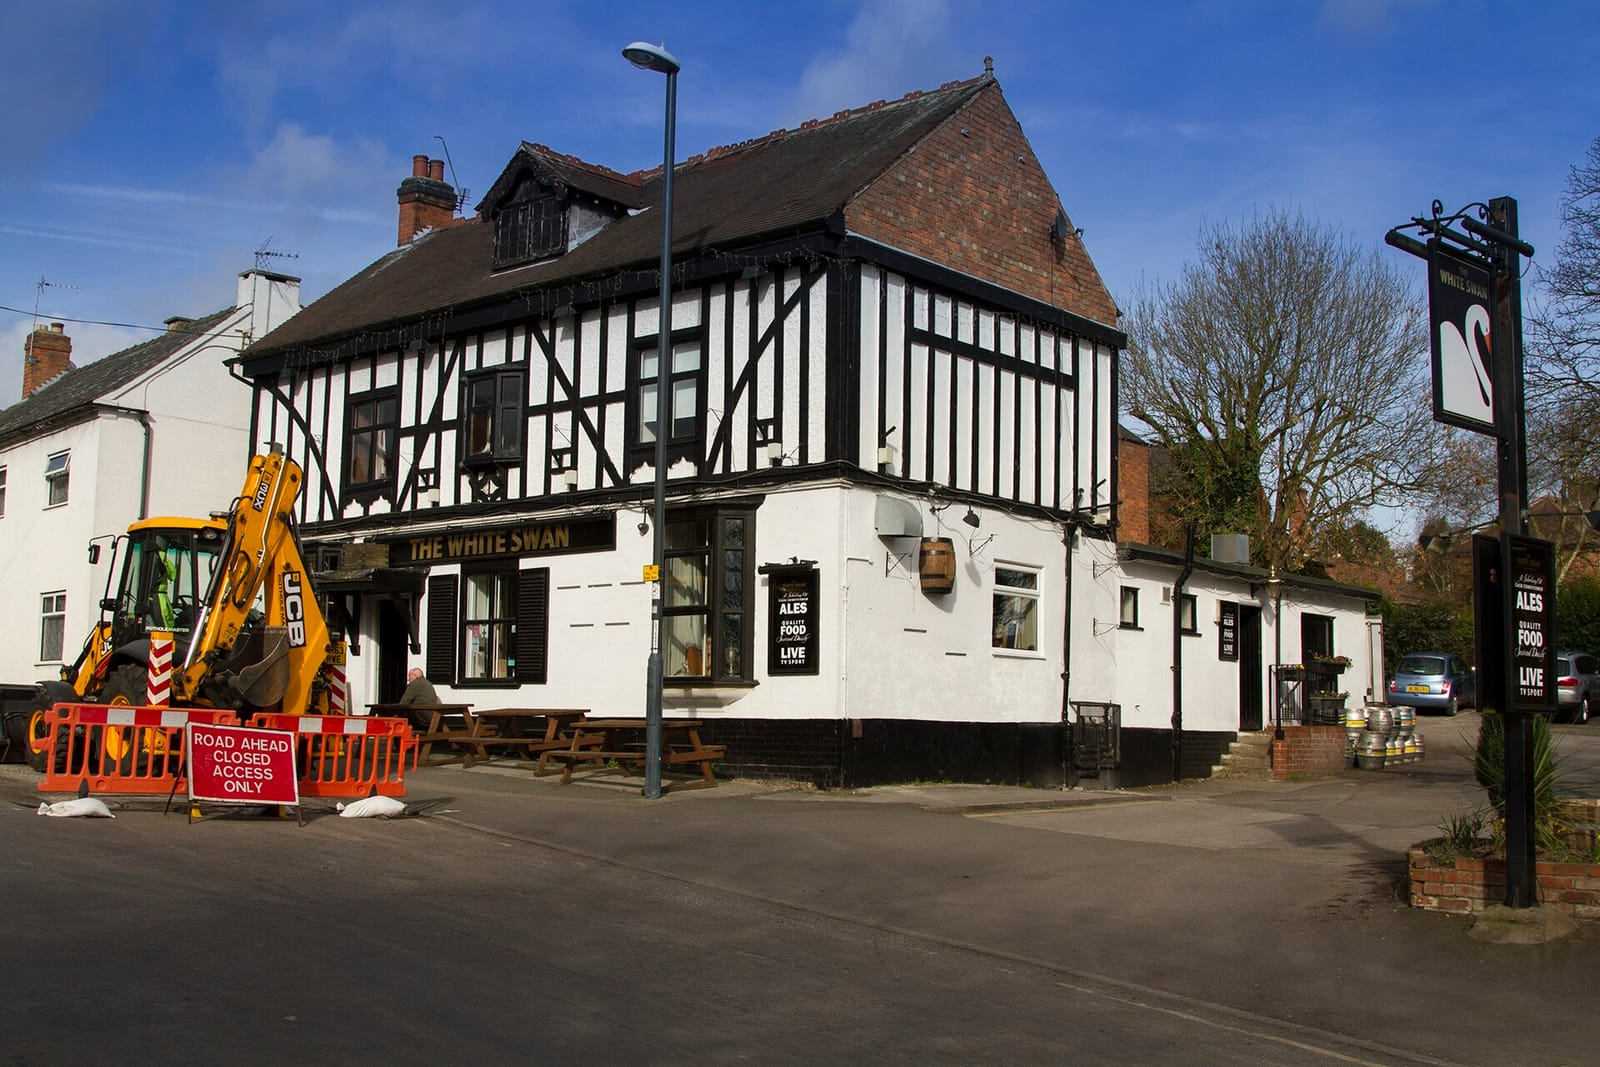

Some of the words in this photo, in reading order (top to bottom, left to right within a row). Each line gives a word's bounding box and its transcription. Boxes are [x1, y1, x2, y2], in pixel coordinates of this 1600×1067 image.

[1440, 268, 1465, 291] WHITE
[1466, 280, 1488, 300] SWAN
[409, 537, 443, 560] THE
[448, 531, 506, 556] WHITE
[510, 525, 569, 552] SWAN
[283, 573, 305, 647] JCB
[779, 602, 808, 615] ALES
[1516, 591, 1544, 613] ALES
[780, 625, 807, 635] FOOD
[1519, 620, 1541, 630] QUALITY
[101, 636, 112, 656] JC
[1518, 629, 1543, 647] FOOD
[780, 646, 806, 659] LIVE
[1520, 666, 1544, 687] LIVE
[194, 733, 235, 748] ROAD
[241, 738, 288, 752] AHEAD
[213, 750, 271, 766] CLOSED
[213, 765, 273, 780] ACCESS
[224, 780, 262, 793] ONLY
